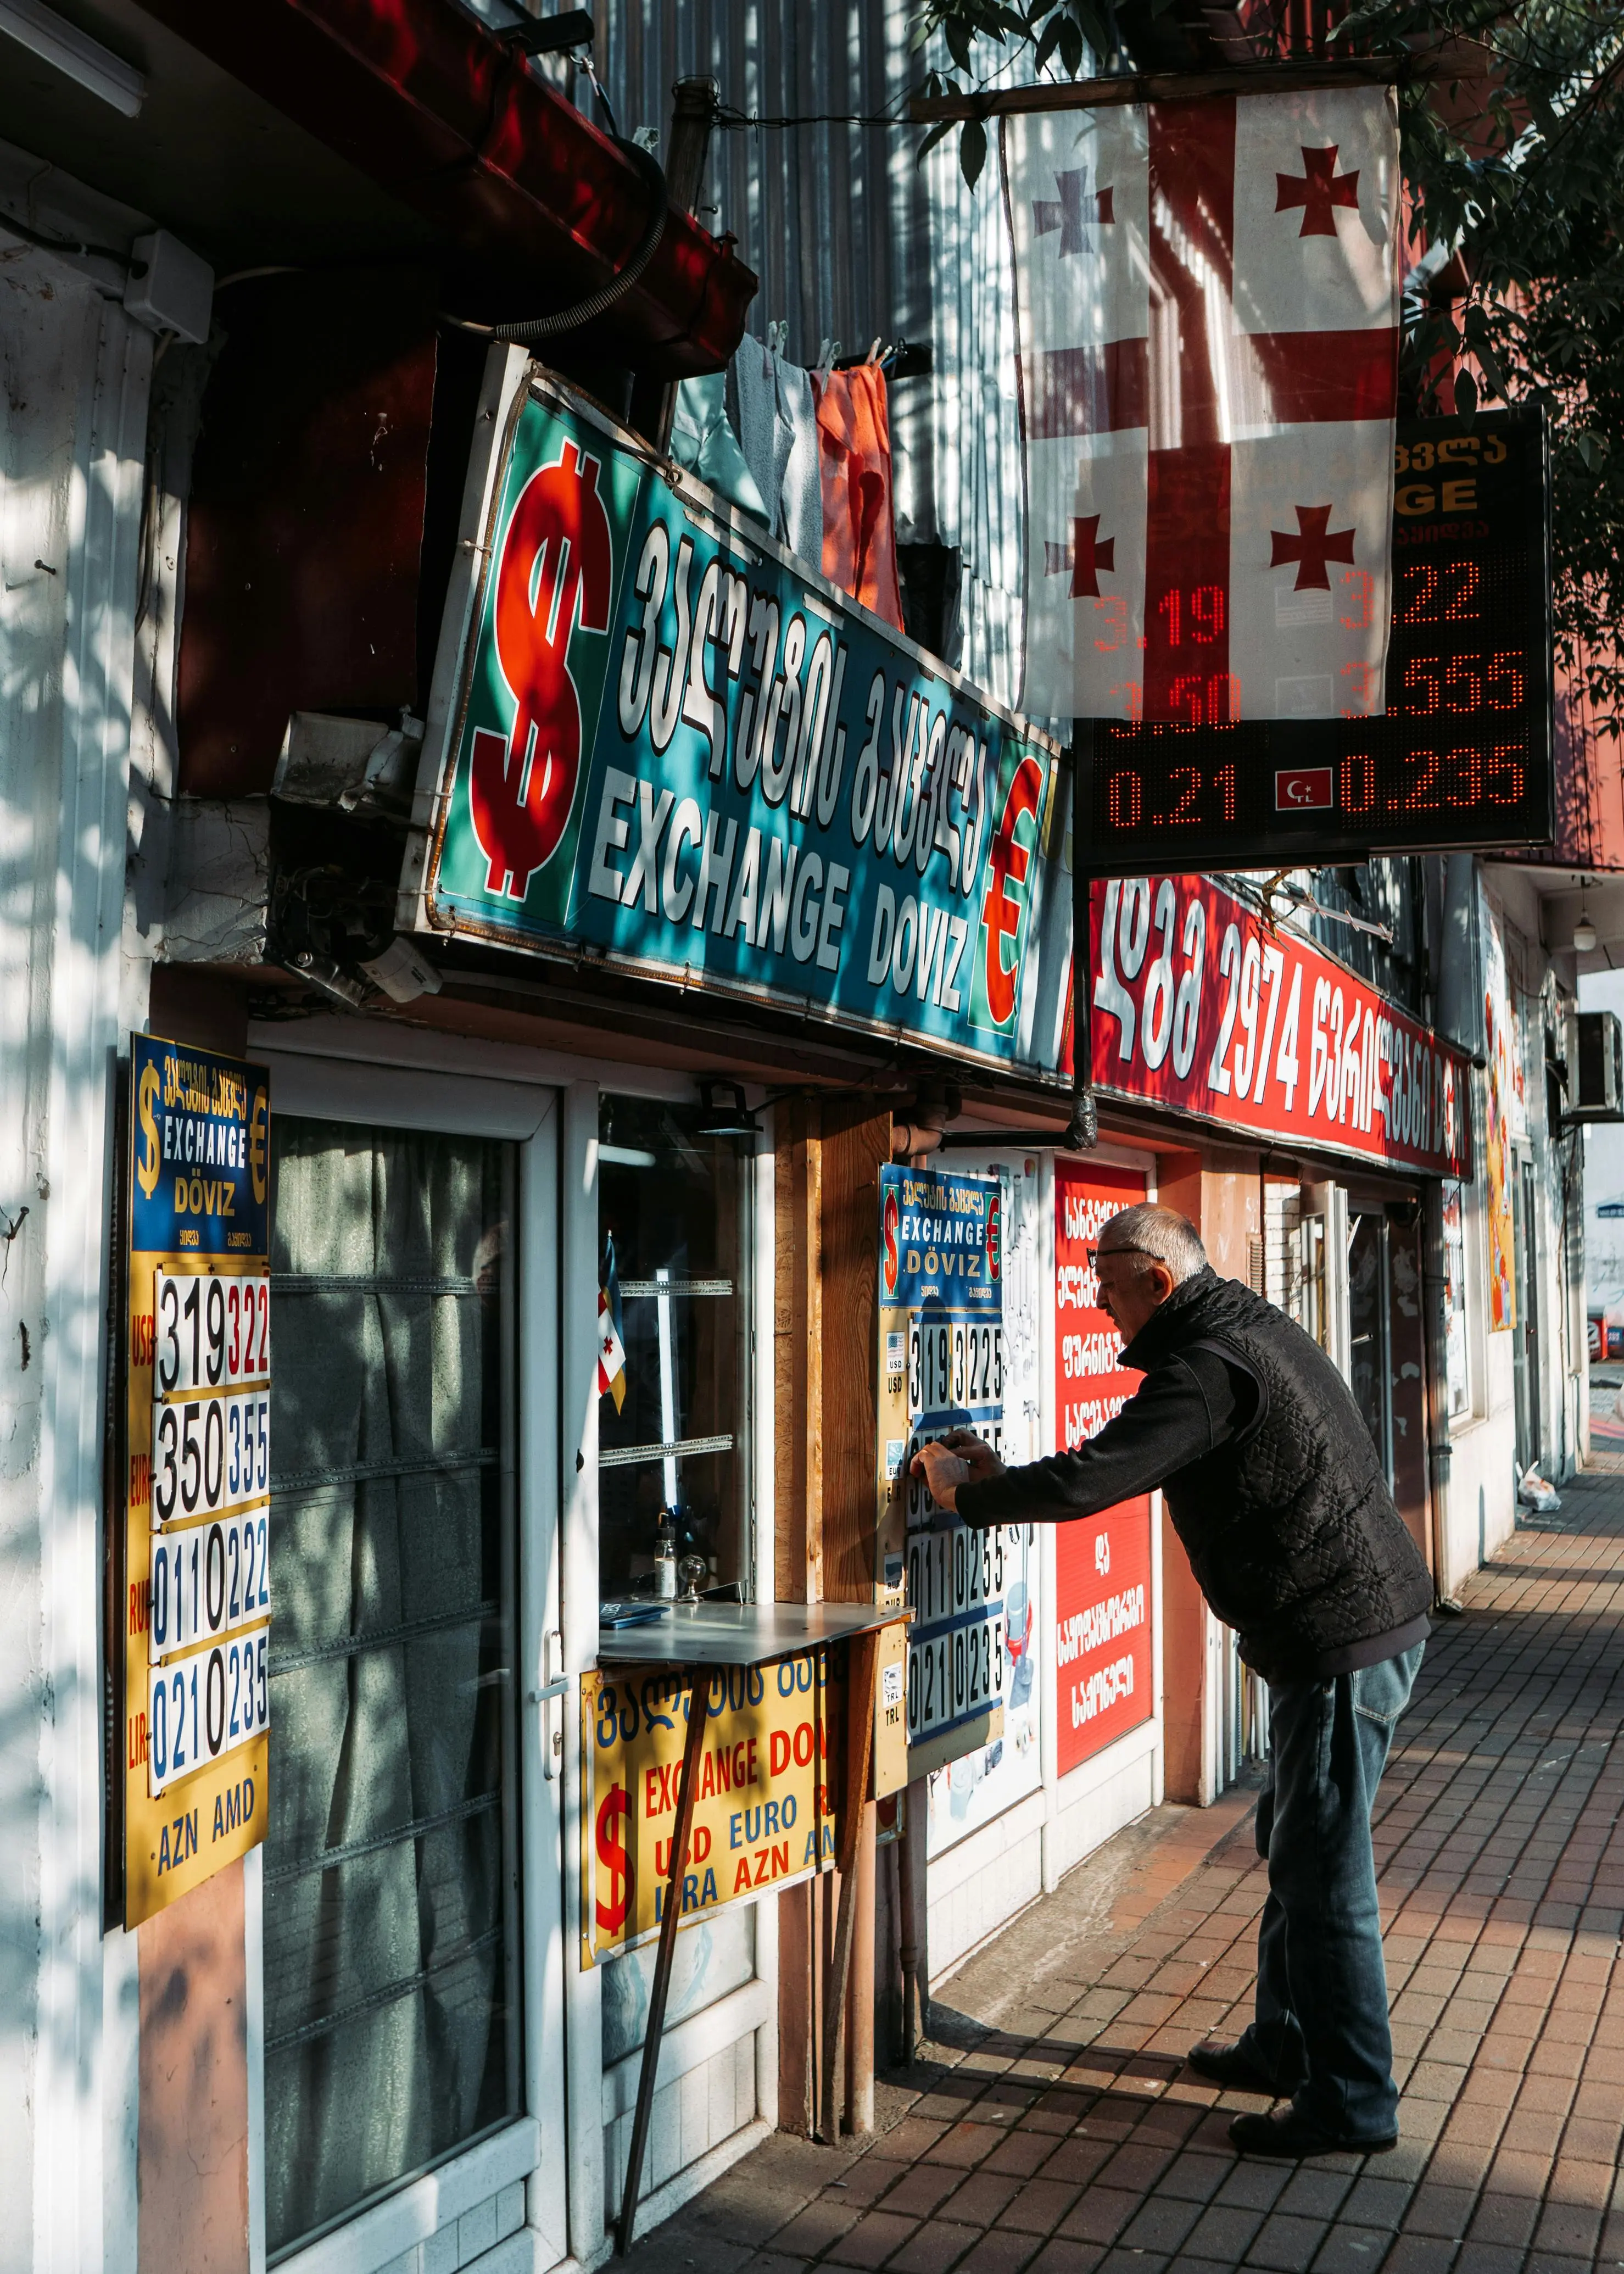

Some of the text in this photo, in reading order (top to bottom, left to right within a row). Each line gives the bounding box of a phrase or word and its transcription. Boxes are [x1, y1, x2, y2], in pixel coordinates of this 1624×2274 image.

[1341, 561, 1480, 630] 3.22
[616, 517, 988, 898] ვალუტის გაცვლა
[1109, 746, 1523, 827] 0.21 TL 0.235
[587, 767, 969, 1013] EXCHANGE DOVIZ
[1208, 923, 1304, 1111] 2974
[164, 1055, 247, 1121] ვალუტის გაცვლა
[164, 1116, 246, 1168] EXCHANGE
[174, 1168, 235, 1216] DÖVIZ
[903, 1179, 984, 1216] ვალუტის გაცვლა
[902, 1216, 983, 1246] EXCHANGE
[907, 1246, 980, 1278] DÖVIZ
[888, 1376, 902, 1394] USD
[890, 1361, 902, 1369] USD
[887, 1485, 901, 1504] ER
[889, 1467, 901, 1476] EUR
[1095, 1532, 1110, 1576] და
[886, 1706, 900, 1726] TRL
[888, 1692, 898, 1702] TRL
[129, 1712, 148, 1769] LIR
[646, 1737, 757, 1819] EXCANGE
[158, 1778, 255, 1877] AZN AMD
[729, 1794, 797, 1851] EURO
[655, 1867, 718, 1924] LRA
[733, 1841, 789, 1894] AZN
